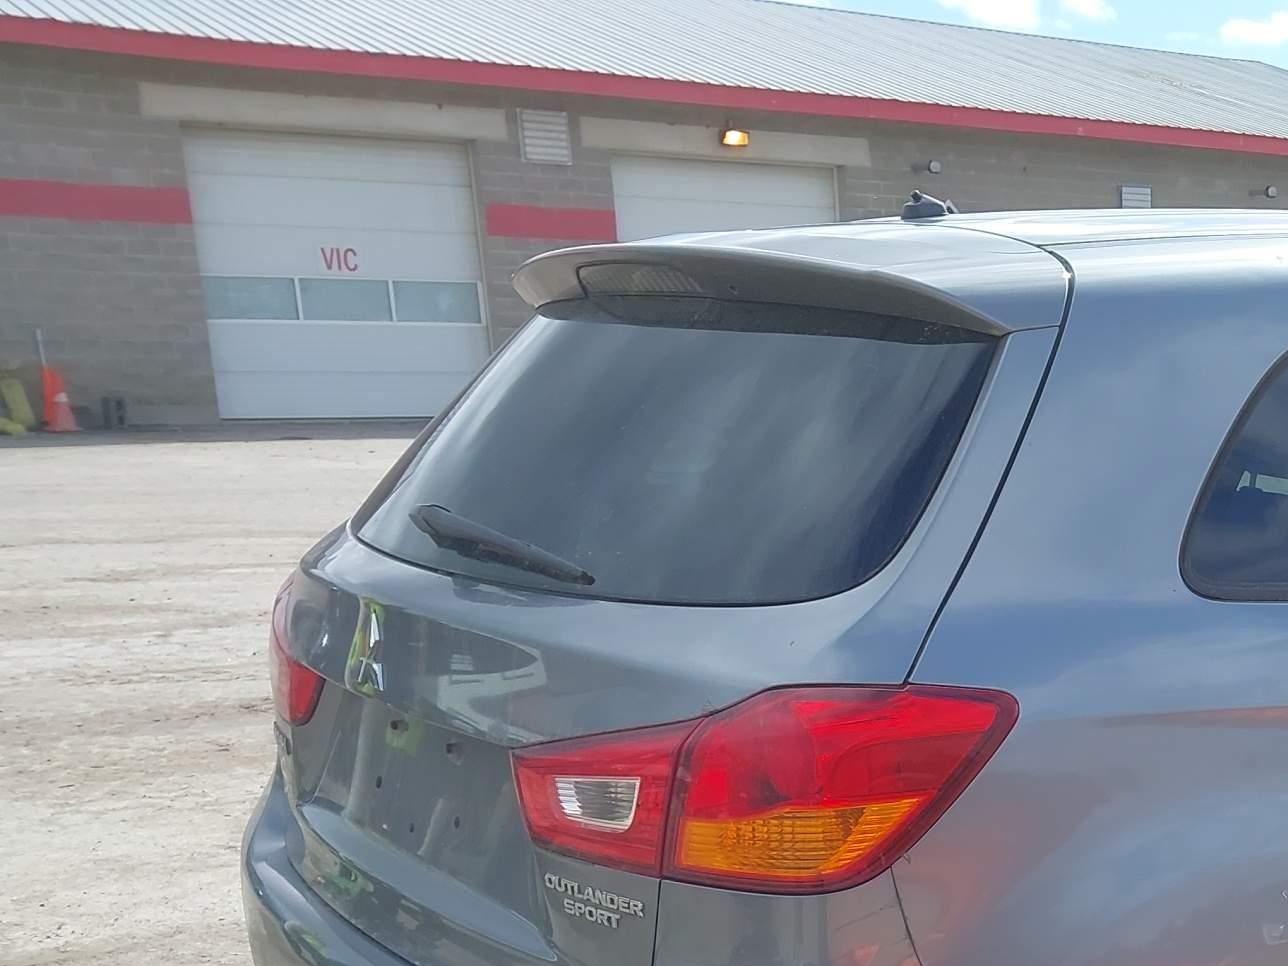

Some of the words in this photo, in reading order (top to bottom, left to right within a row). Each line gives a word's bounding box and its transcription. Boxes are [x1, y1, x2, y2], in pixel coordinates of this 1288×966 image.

[320, 247, 358, 272] VIC
[544, 872, 644, 918] OUTLANDER
[563, 898, 621, 929] SPORT
